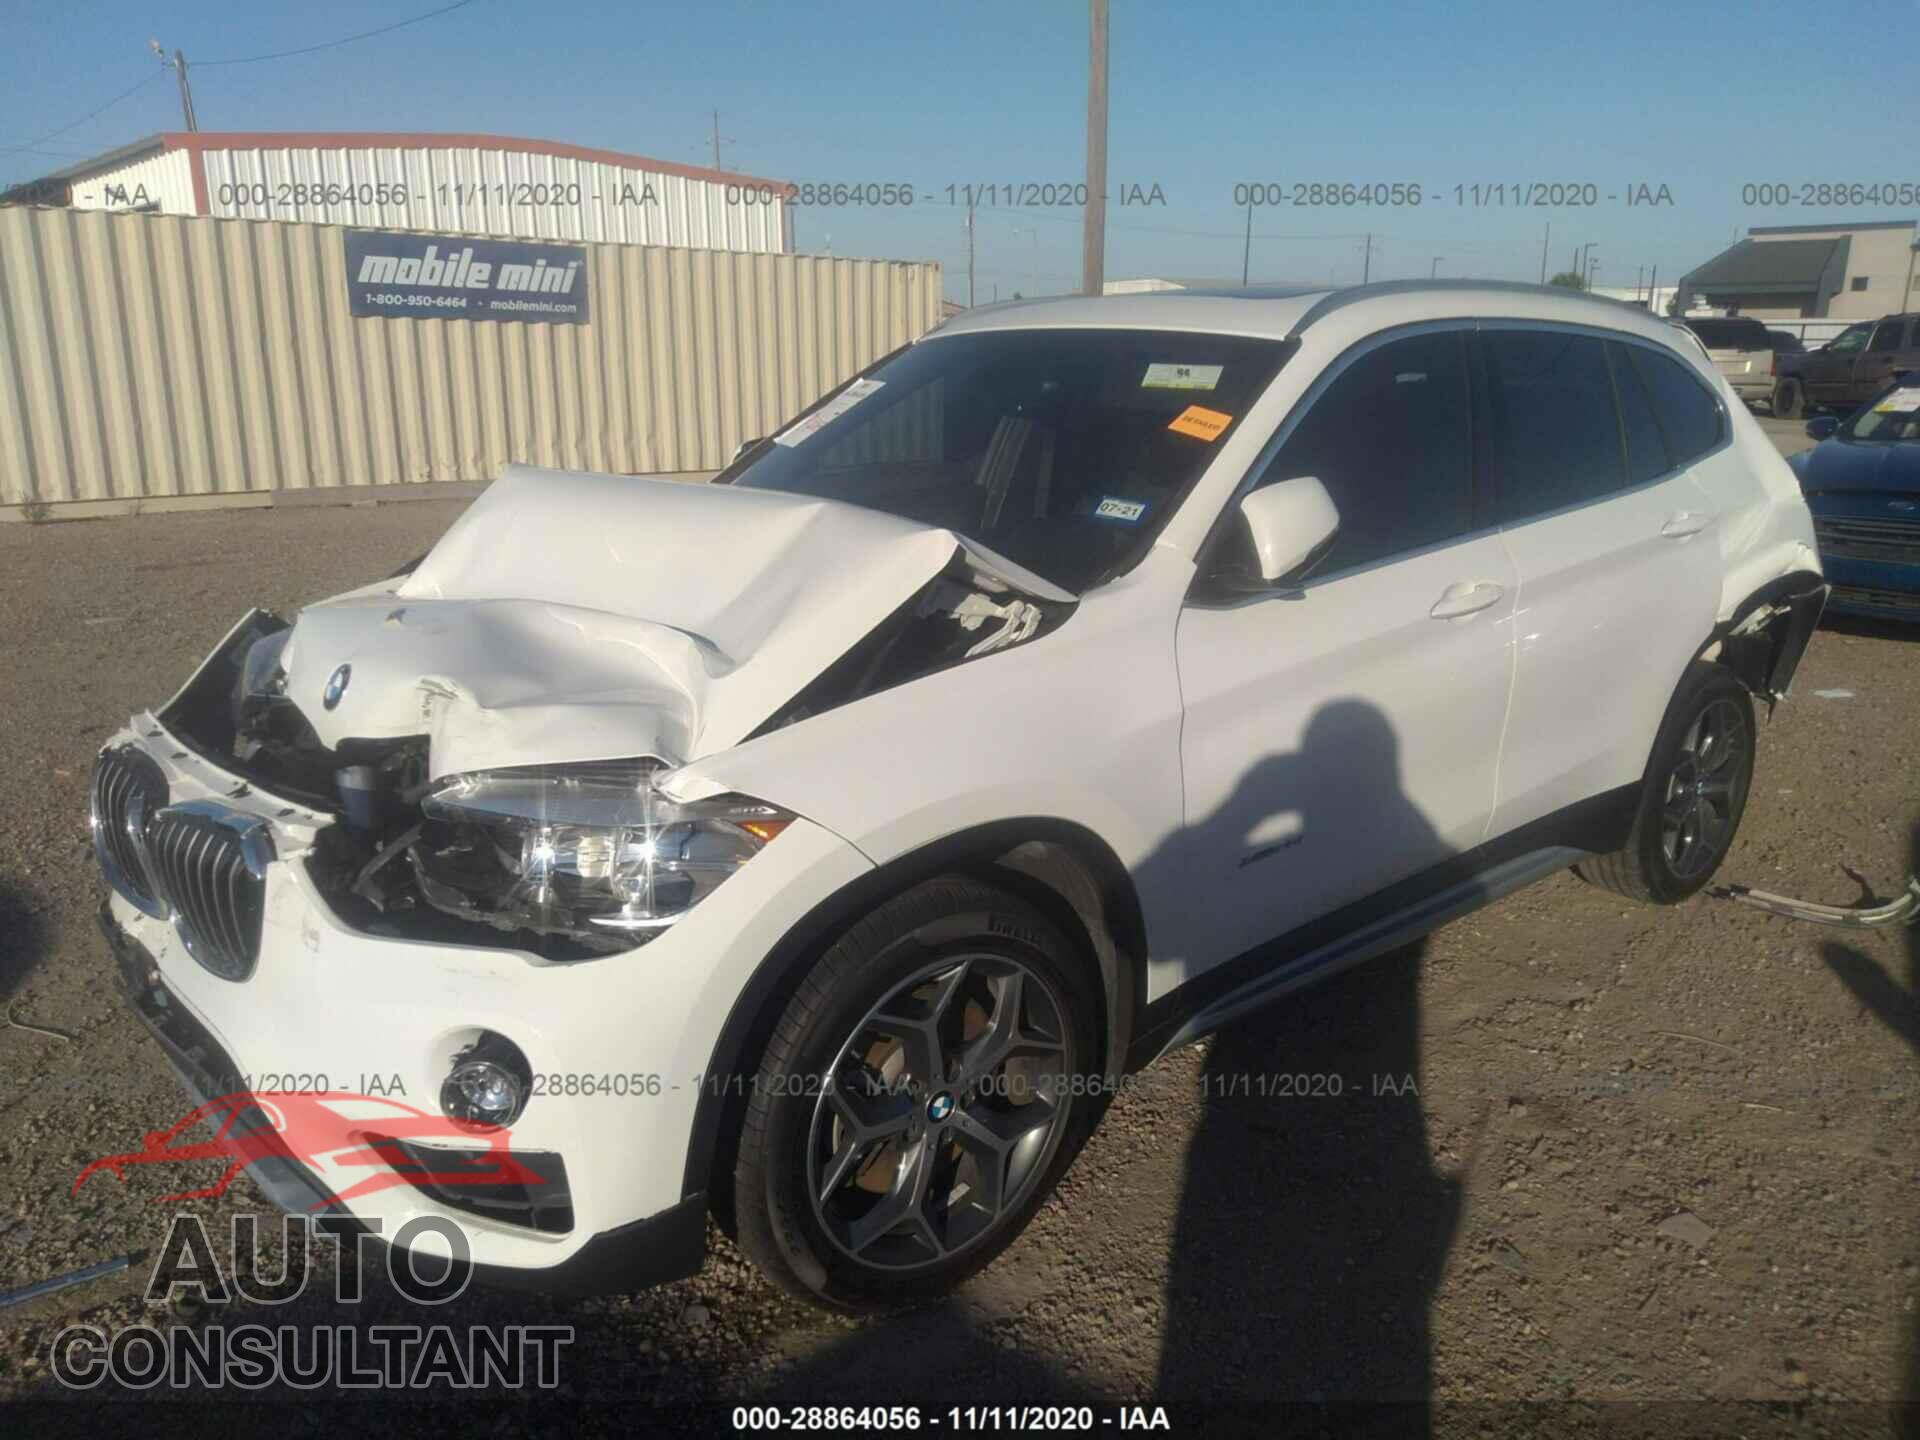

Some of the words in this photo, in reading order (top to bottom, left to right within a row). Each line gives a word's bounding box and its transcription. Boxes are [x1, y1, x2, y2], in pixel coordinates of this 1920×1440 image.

[357, 245, 492, 289] mobile
[496, 258, 578, 294] mini
[365, 293, 467, 308] 1-800-950-6464
[490, 299, 577, 314] mobilemini.com
